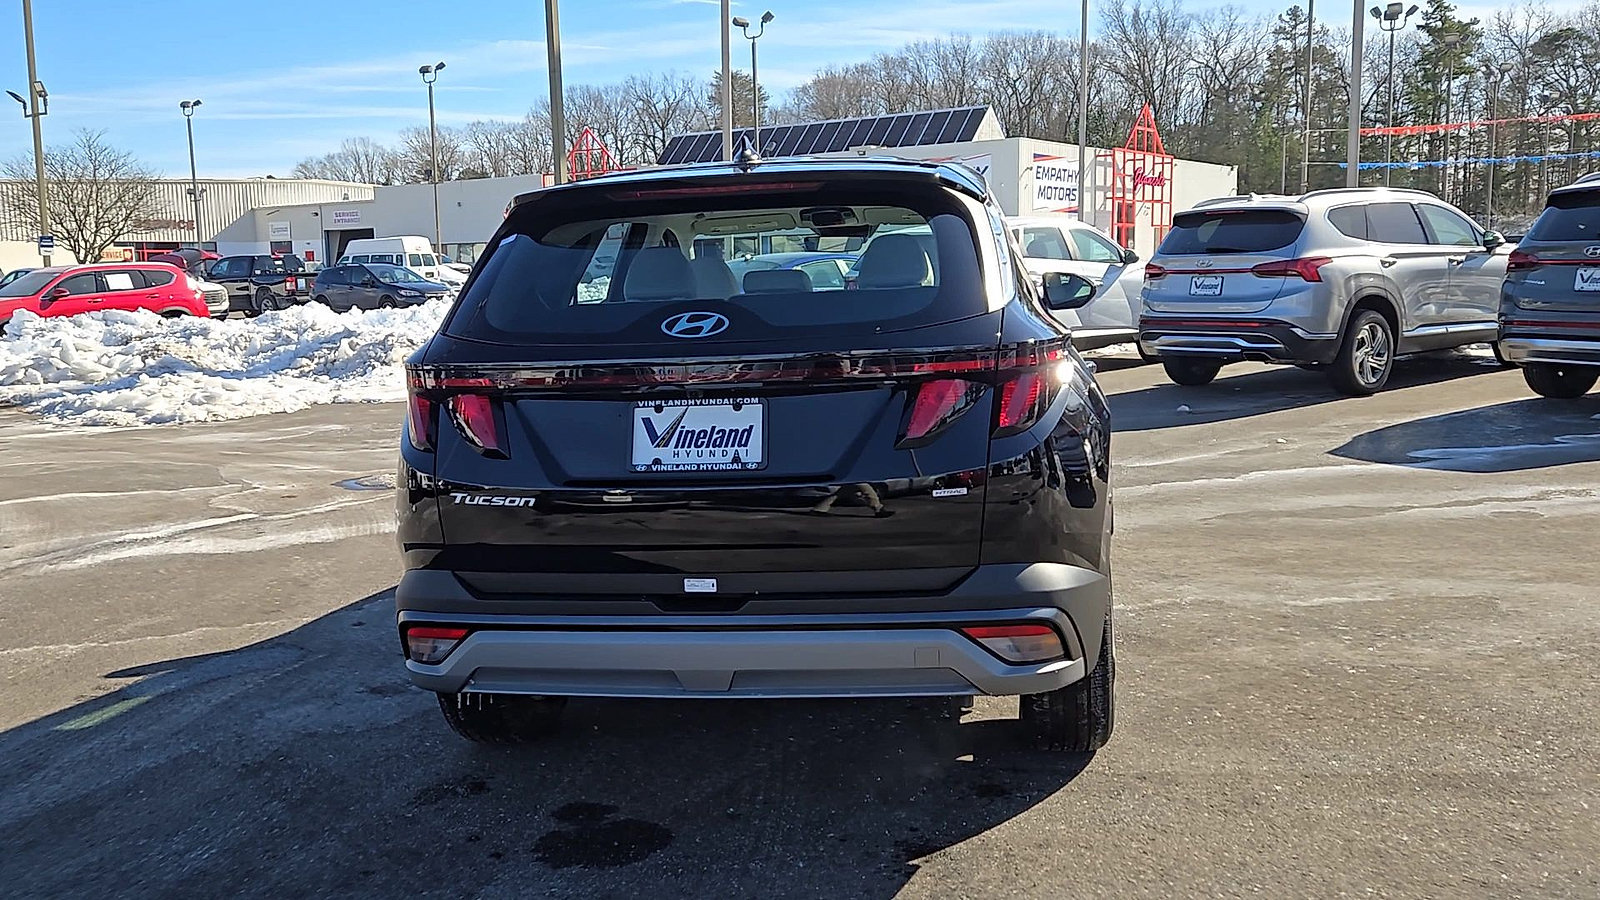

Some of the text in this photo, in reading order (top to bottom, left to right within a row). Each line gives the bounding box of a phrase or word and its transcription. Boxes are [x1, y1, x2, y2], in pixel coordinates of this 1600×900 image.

[1035, 165, 1080, 183] EMPATHY
[1037, 185, 1077, 201] MOTORS
[640, 406, 754, 449] Vineland
[673, 449, 749, 458] HYUNDAI
[700, 463, 742, 471] HYUNDAI
